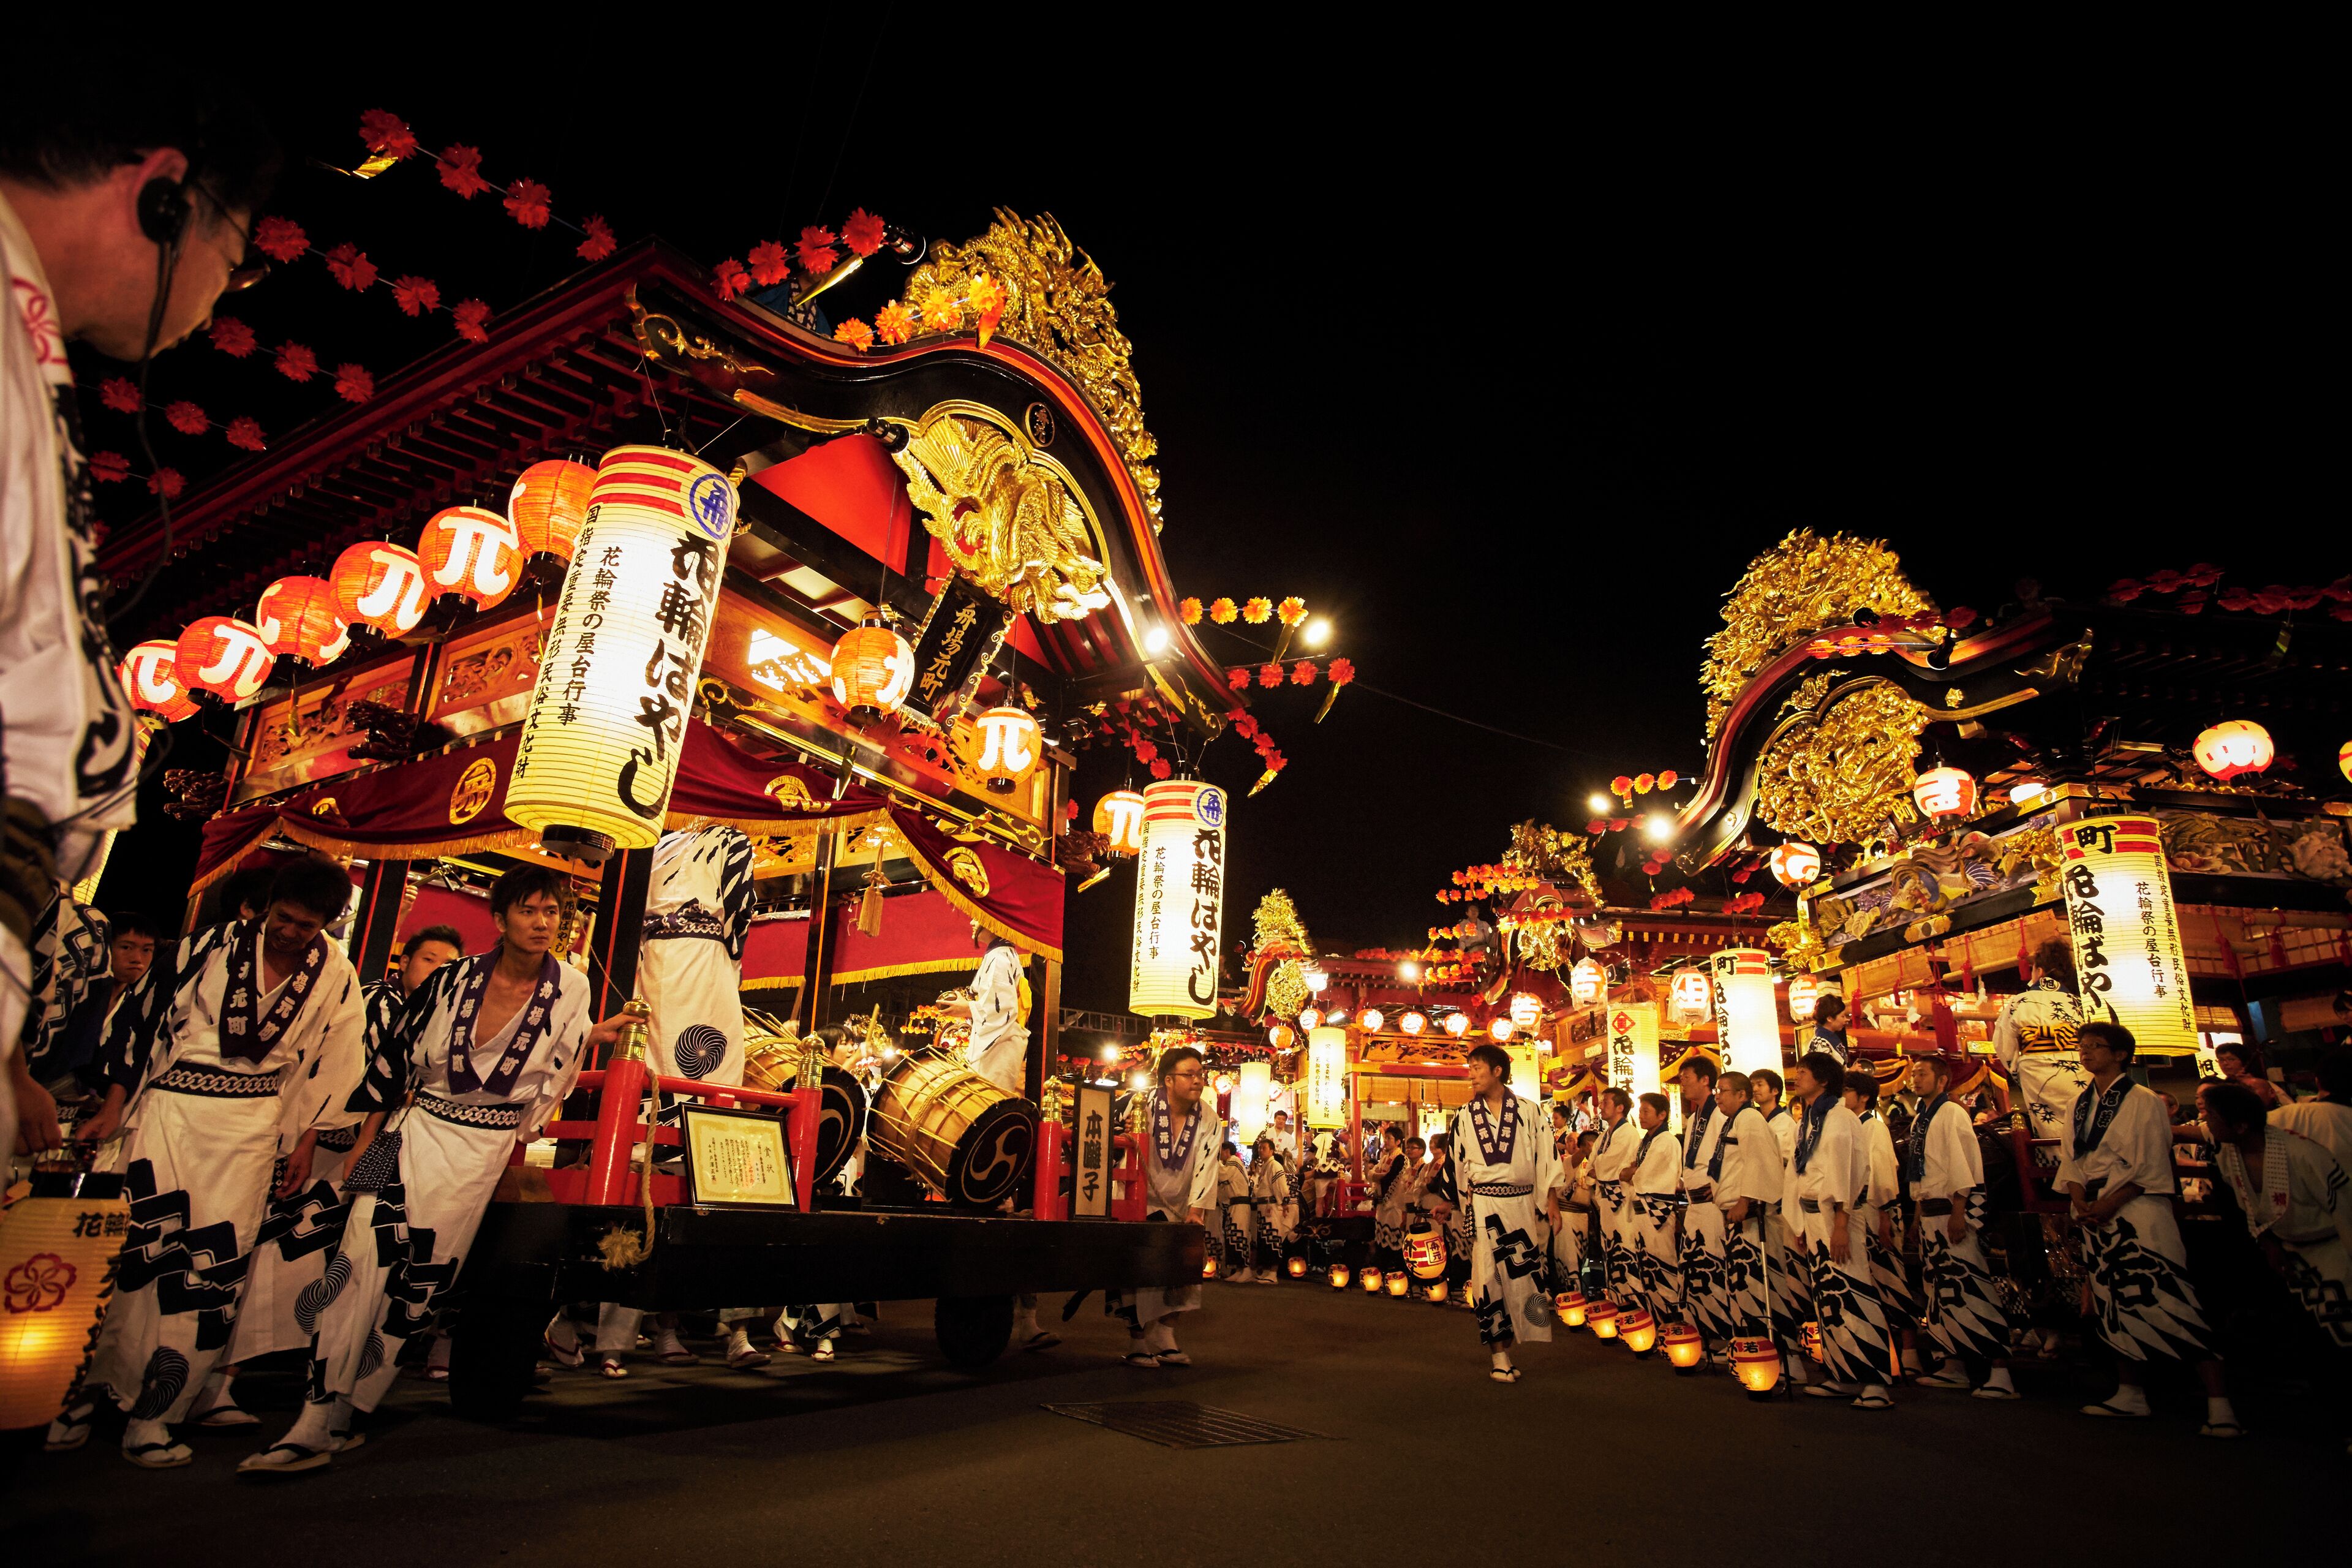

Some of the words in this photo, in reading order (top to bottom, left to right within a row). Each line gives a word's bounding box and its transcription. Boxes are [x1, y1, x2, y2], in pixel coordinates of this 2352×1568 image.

[514, 505, 601, 779] 国指定重要無形民俗文化財
[557, 546, 623, 726] 花輪祭の屋台行事
[617, 530, 719, 820] 花輪ばやし
[920, 603, 976, 701] 舟場元町
[1133, 821, 1150, 993] 国指定重要無形民俗文化財
[1149, 846, 1167, 960] 花輪祭の屋台行事
[2075, 824, 2117, 855] 町
[1188, 827, 1221, 1006] 花輪ばやし
[1715, 956, 1739, 976] 町
[2135, 881, 2168, 998] 花輪祭の屋台行事
[2154, 854, 2192, 1033] 国指定重要無形民俗文化財
[2198, 1058, 2218, 1077] 旭
